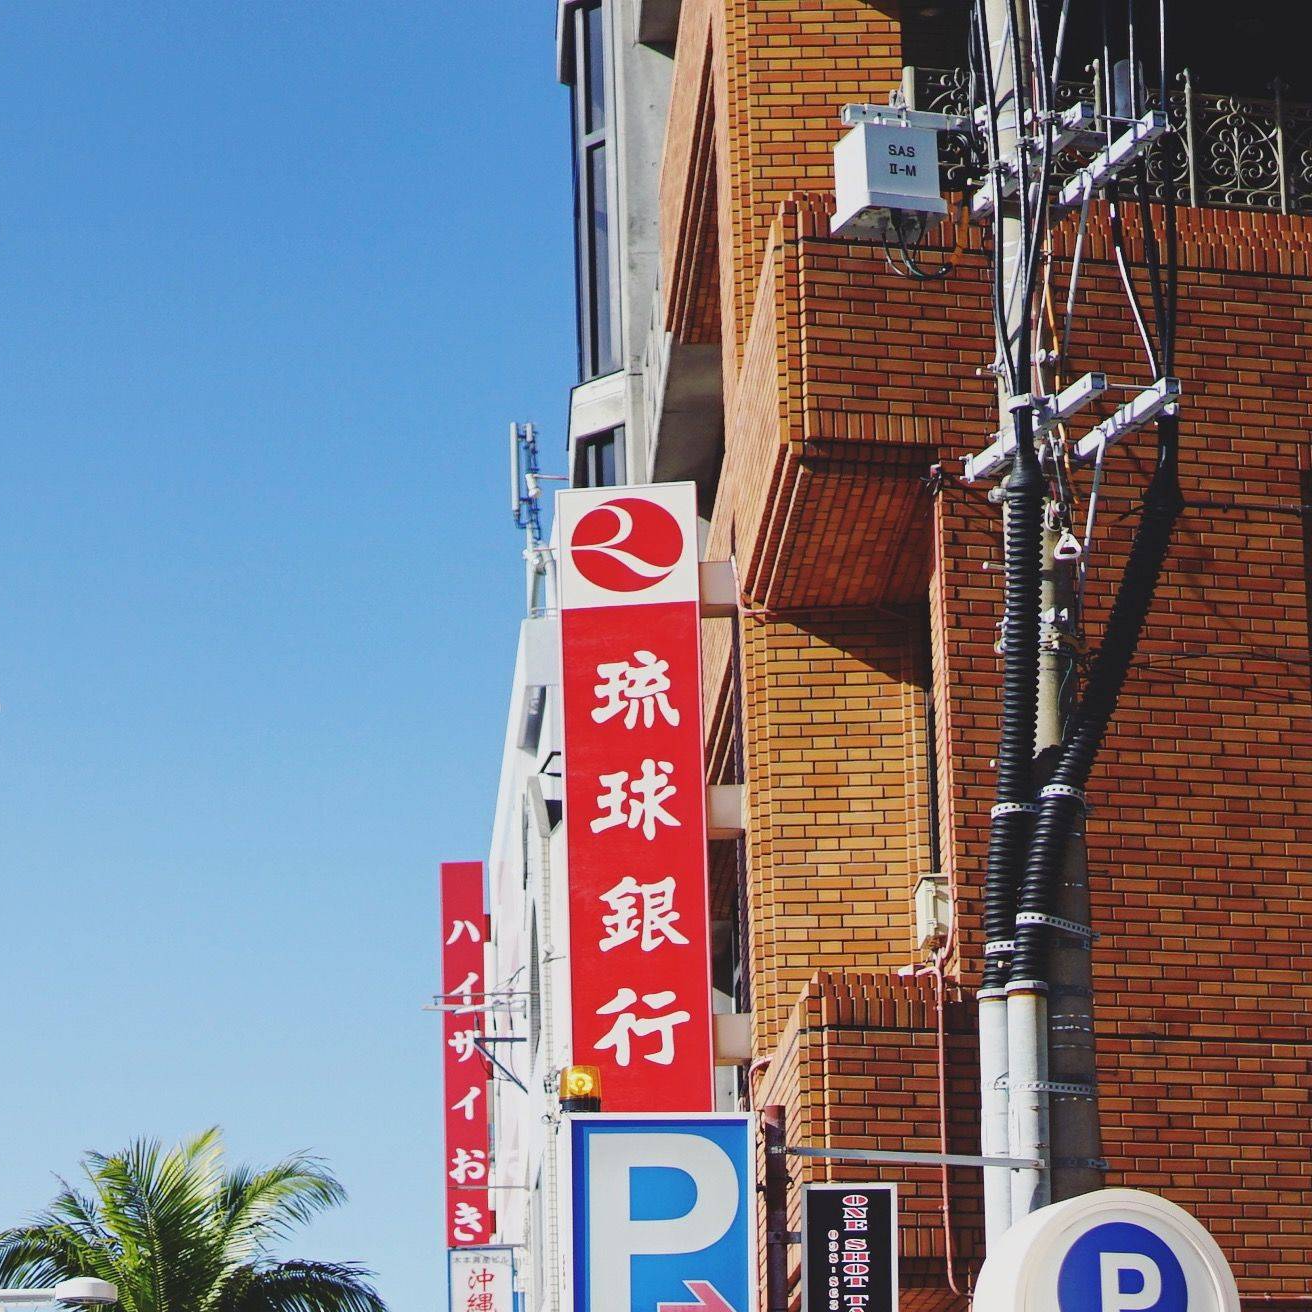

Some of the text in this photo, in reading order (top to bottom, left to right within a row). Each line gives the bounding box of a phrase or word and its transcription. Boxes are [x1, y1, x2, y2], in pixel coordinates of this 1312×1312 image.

[888, 144, 915, 158] SAS
[589, 650, 691, 1068] 琉球銀行
[842, 1194, 869, 1231] ONE
[841, 1238, 871, 1288] SHOT
